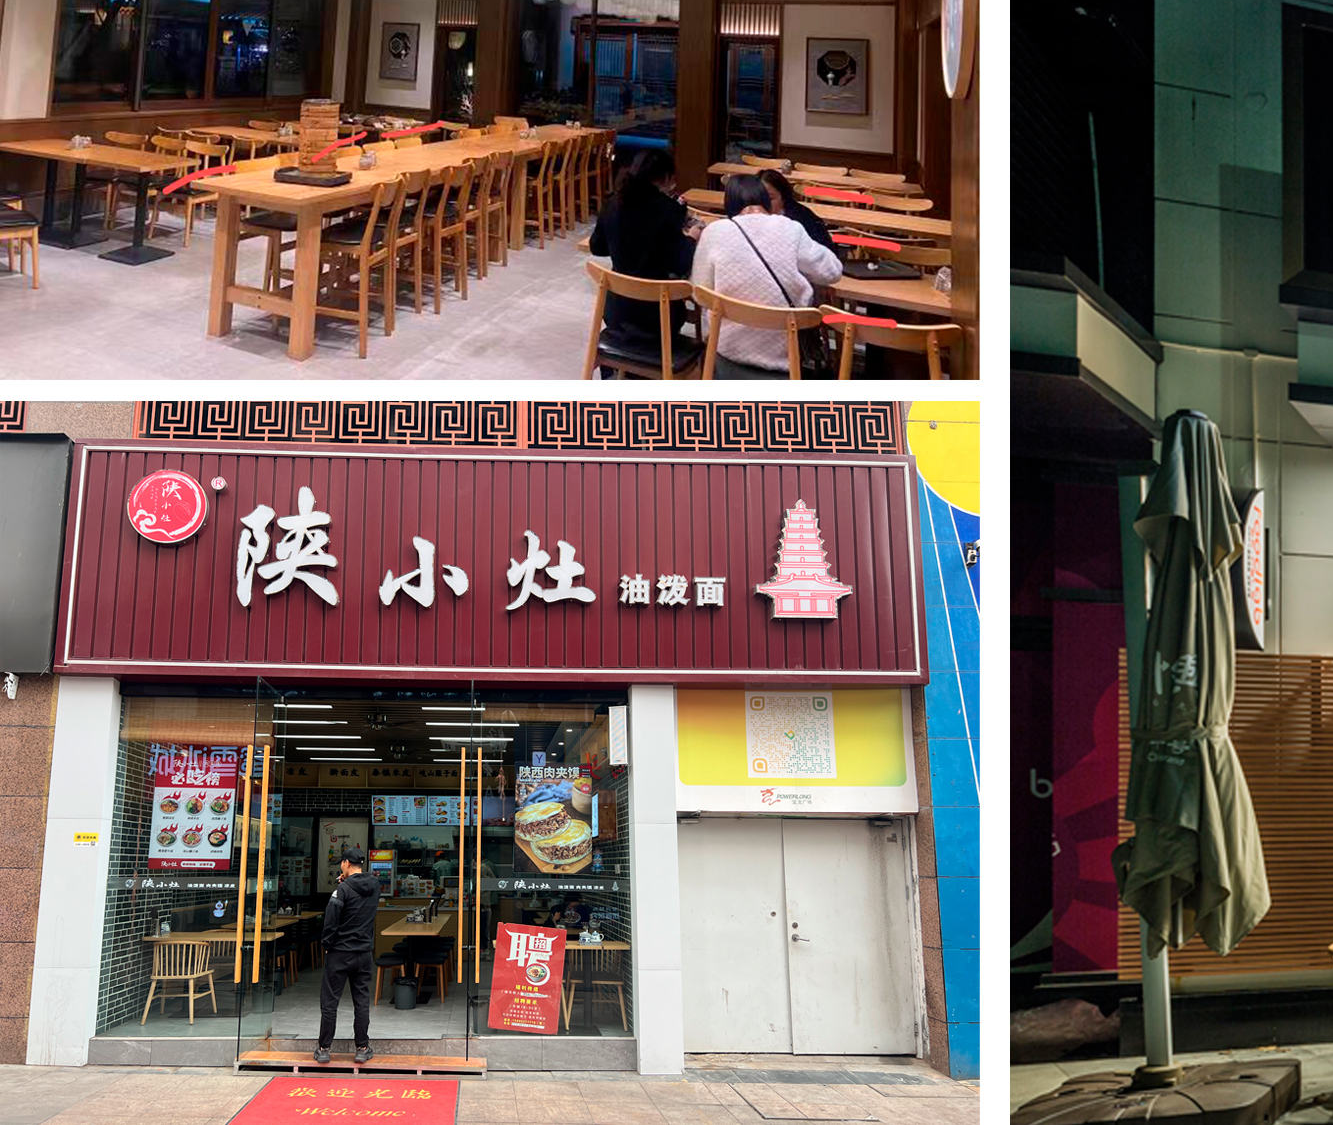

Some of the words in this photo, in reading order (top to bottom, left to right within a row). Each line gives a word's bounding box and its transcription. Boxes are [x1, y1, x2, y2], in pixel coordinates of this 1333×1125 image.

[236, 485, 597, 611] 陕小灶
[617, 573, 727, 607] 油泼面
[171, 768, 221, 786] 必吃榜
[518, 766, 580, 780] 陕西肉夹馍
[295, 1106, 406, 1117] Welcome
